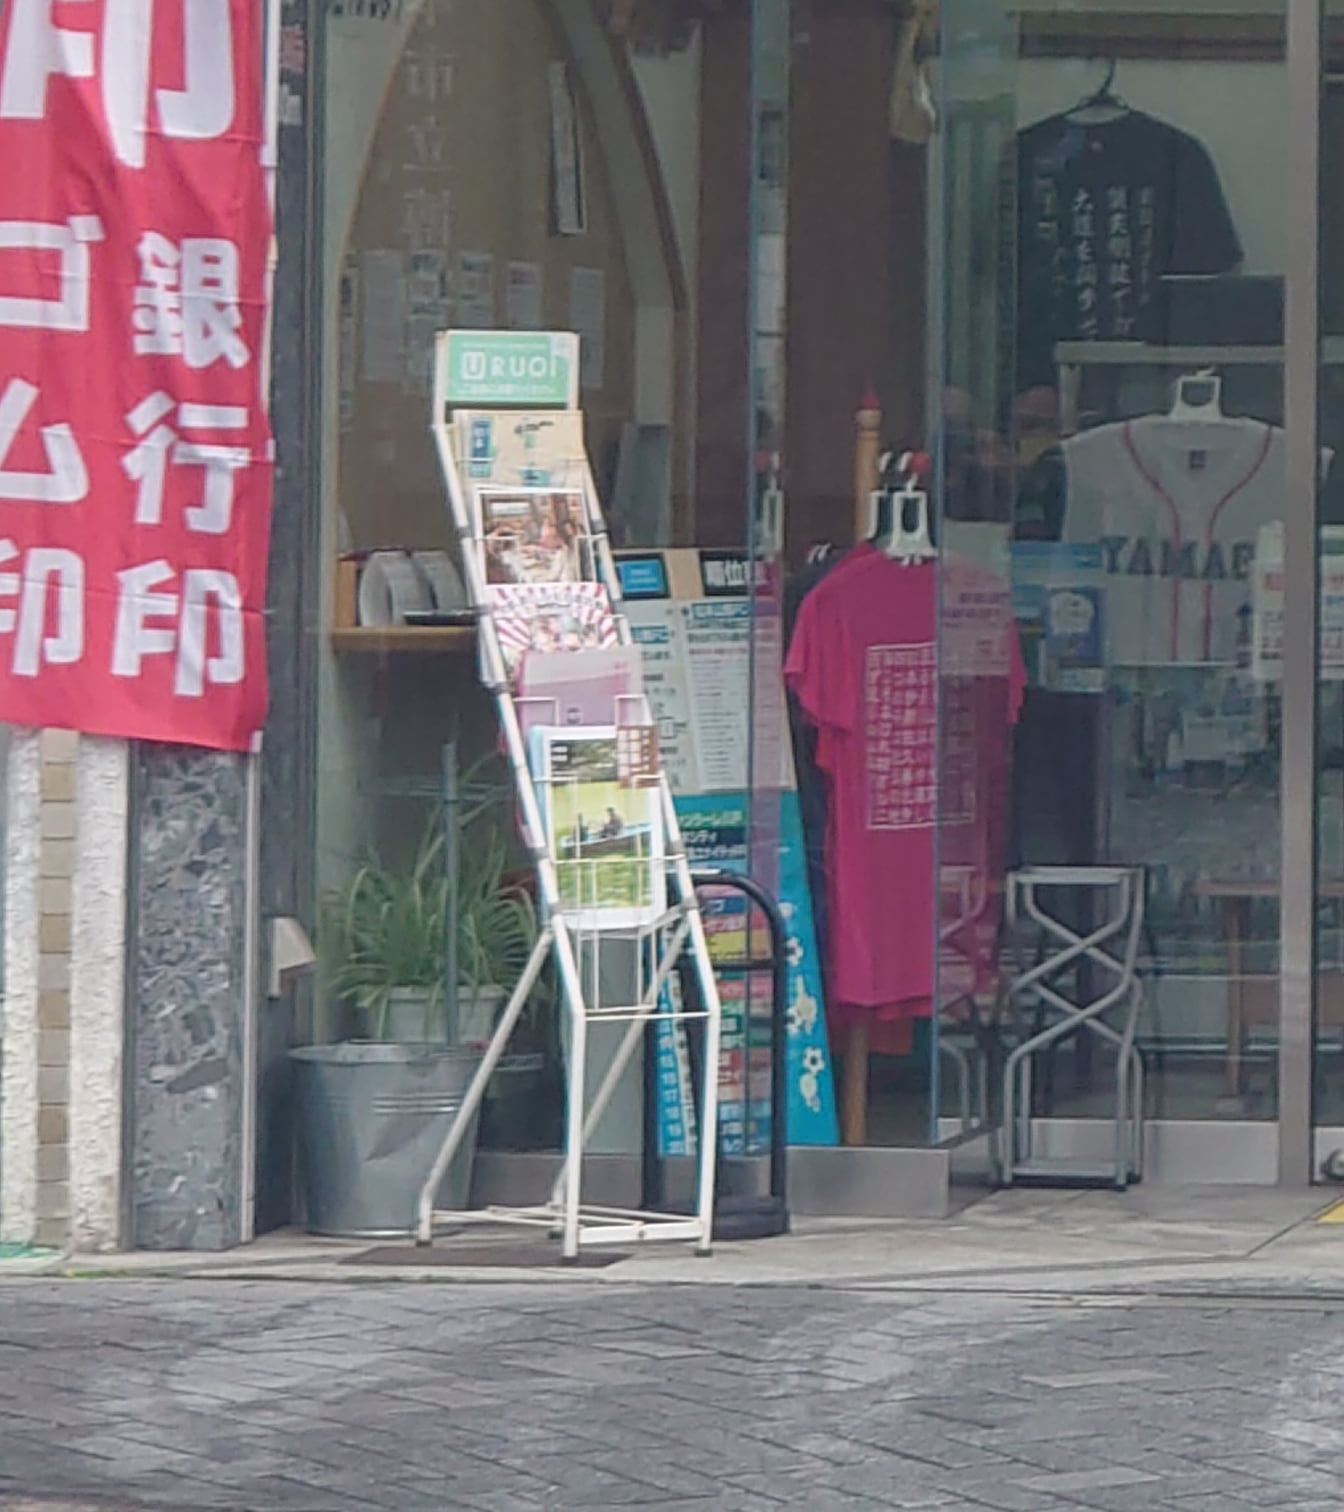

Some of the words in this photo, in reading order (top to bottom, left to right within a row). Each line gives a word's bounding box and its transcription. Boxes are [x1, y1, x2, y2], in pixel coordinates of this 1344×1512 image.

[0, 214, 106, 678] ゴム印
[110, 230, 252, 697] 銀行印
